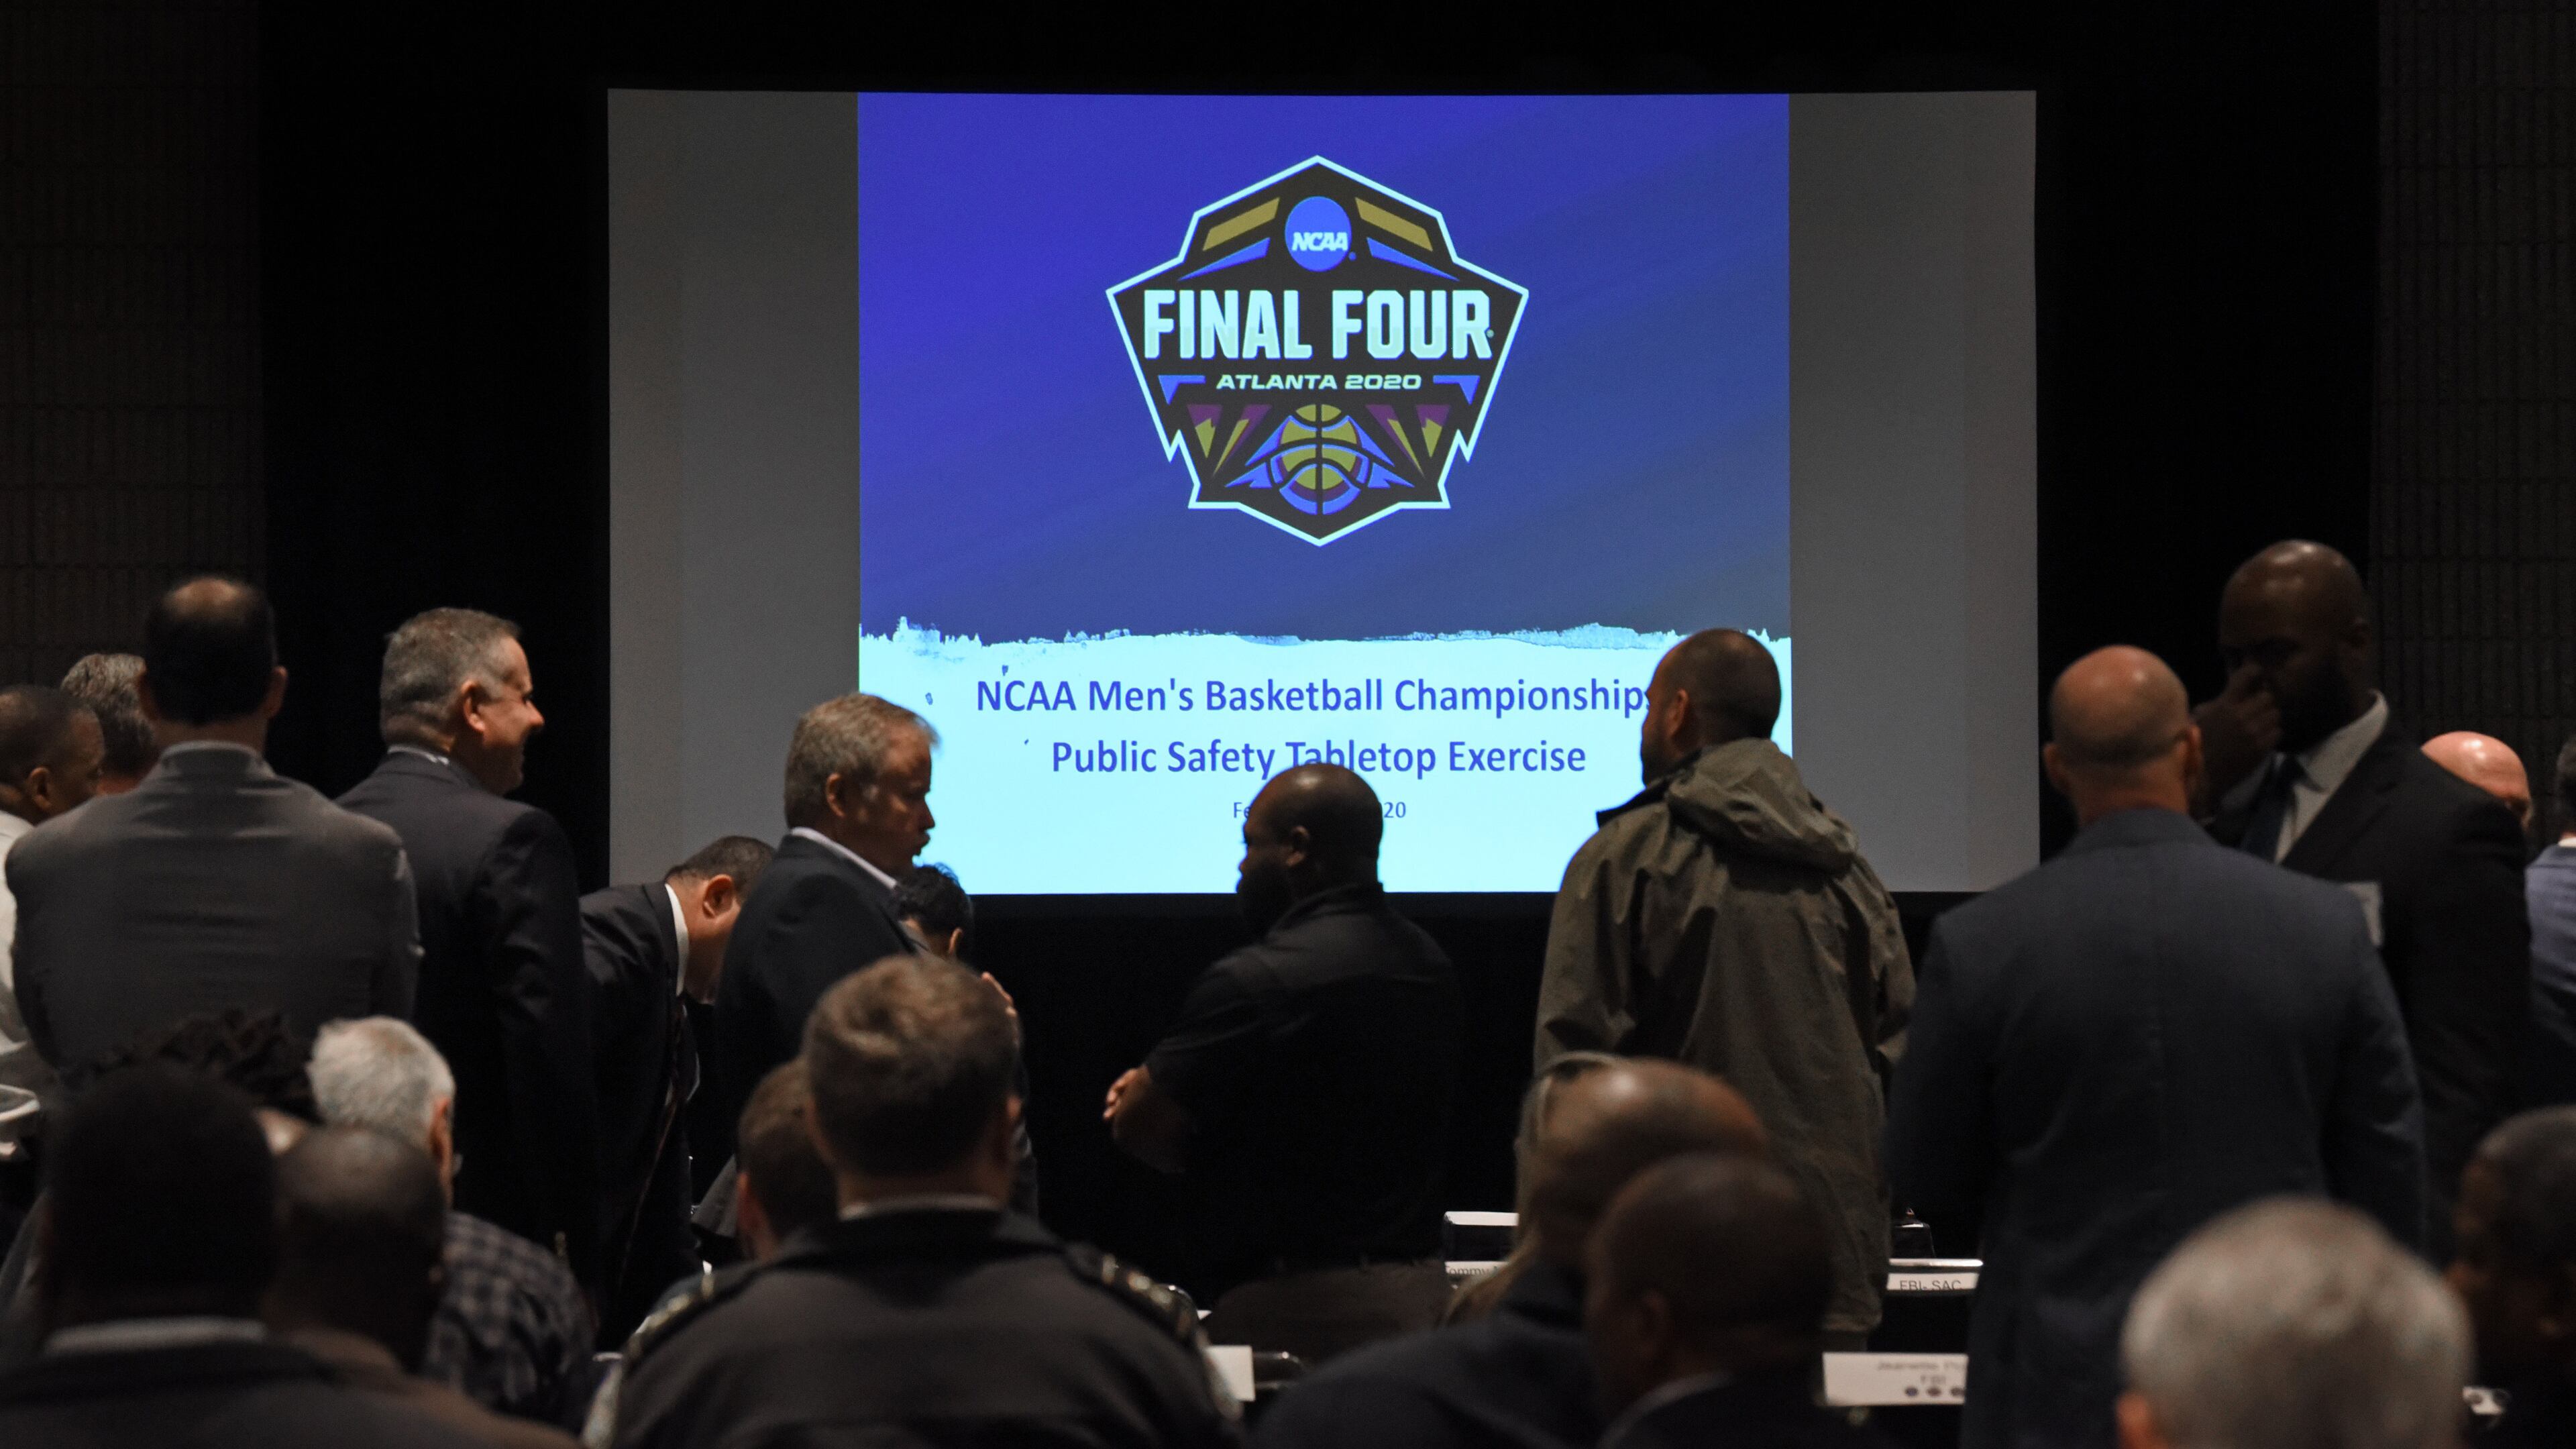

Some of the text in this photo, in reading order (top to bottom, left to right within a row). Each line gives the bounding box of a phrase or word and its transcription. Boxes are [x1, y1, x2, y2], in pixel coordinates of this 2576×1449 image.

[1291, 231, 1348, 252] NCAA
[1144, 290, 1493, 359] FINAL FOUR
[1216, 374, 1421, 390] ATLANTA 2020
[977, 678, 1650, 718] NCAA Men's Basketball Championship
[1053, 739, 1586, 780] Public Safety Tabletop Exercise
